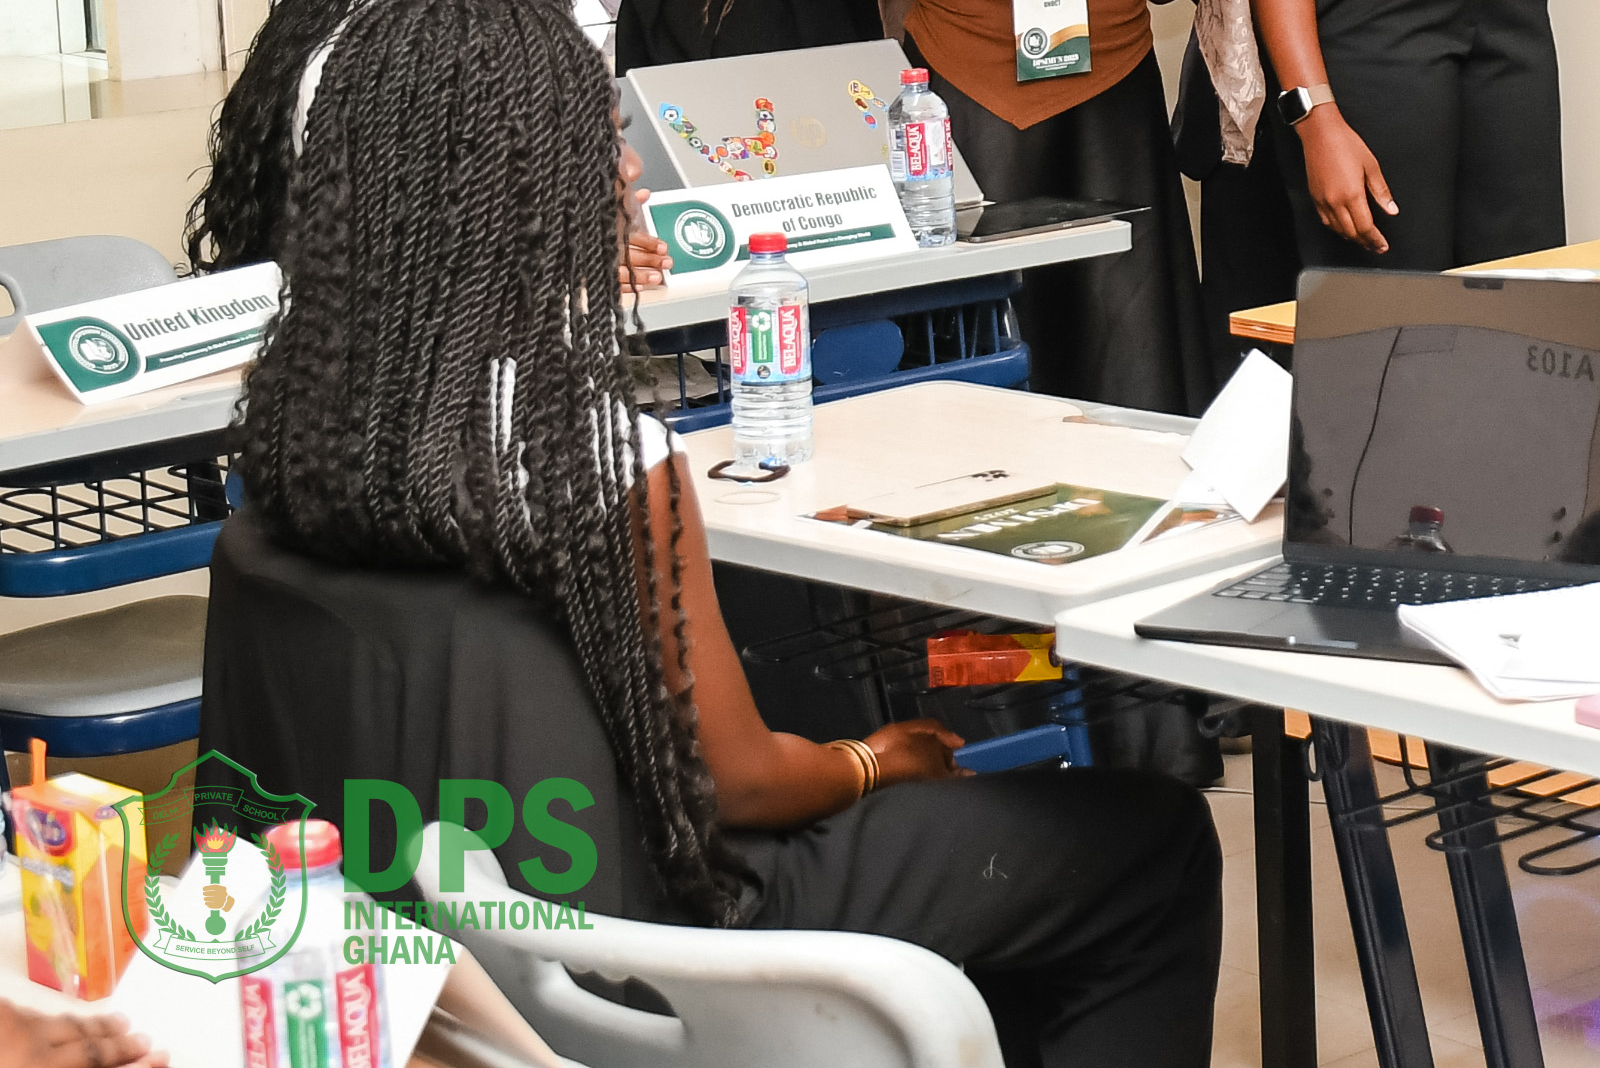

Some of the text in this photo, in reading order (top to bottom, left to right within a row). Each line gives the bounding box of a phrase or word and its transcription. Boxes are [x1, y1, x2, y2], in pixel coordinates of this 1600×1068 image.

[907, 125, 922, 171] BEL-AQUA
[731, 185, 877, 218] Democratic Republic
[782, 212, 843, 233] of Congo
[123, 293, 276, 342] United Kingdom
[782, 309, 797, 367] BEL-AQUA
